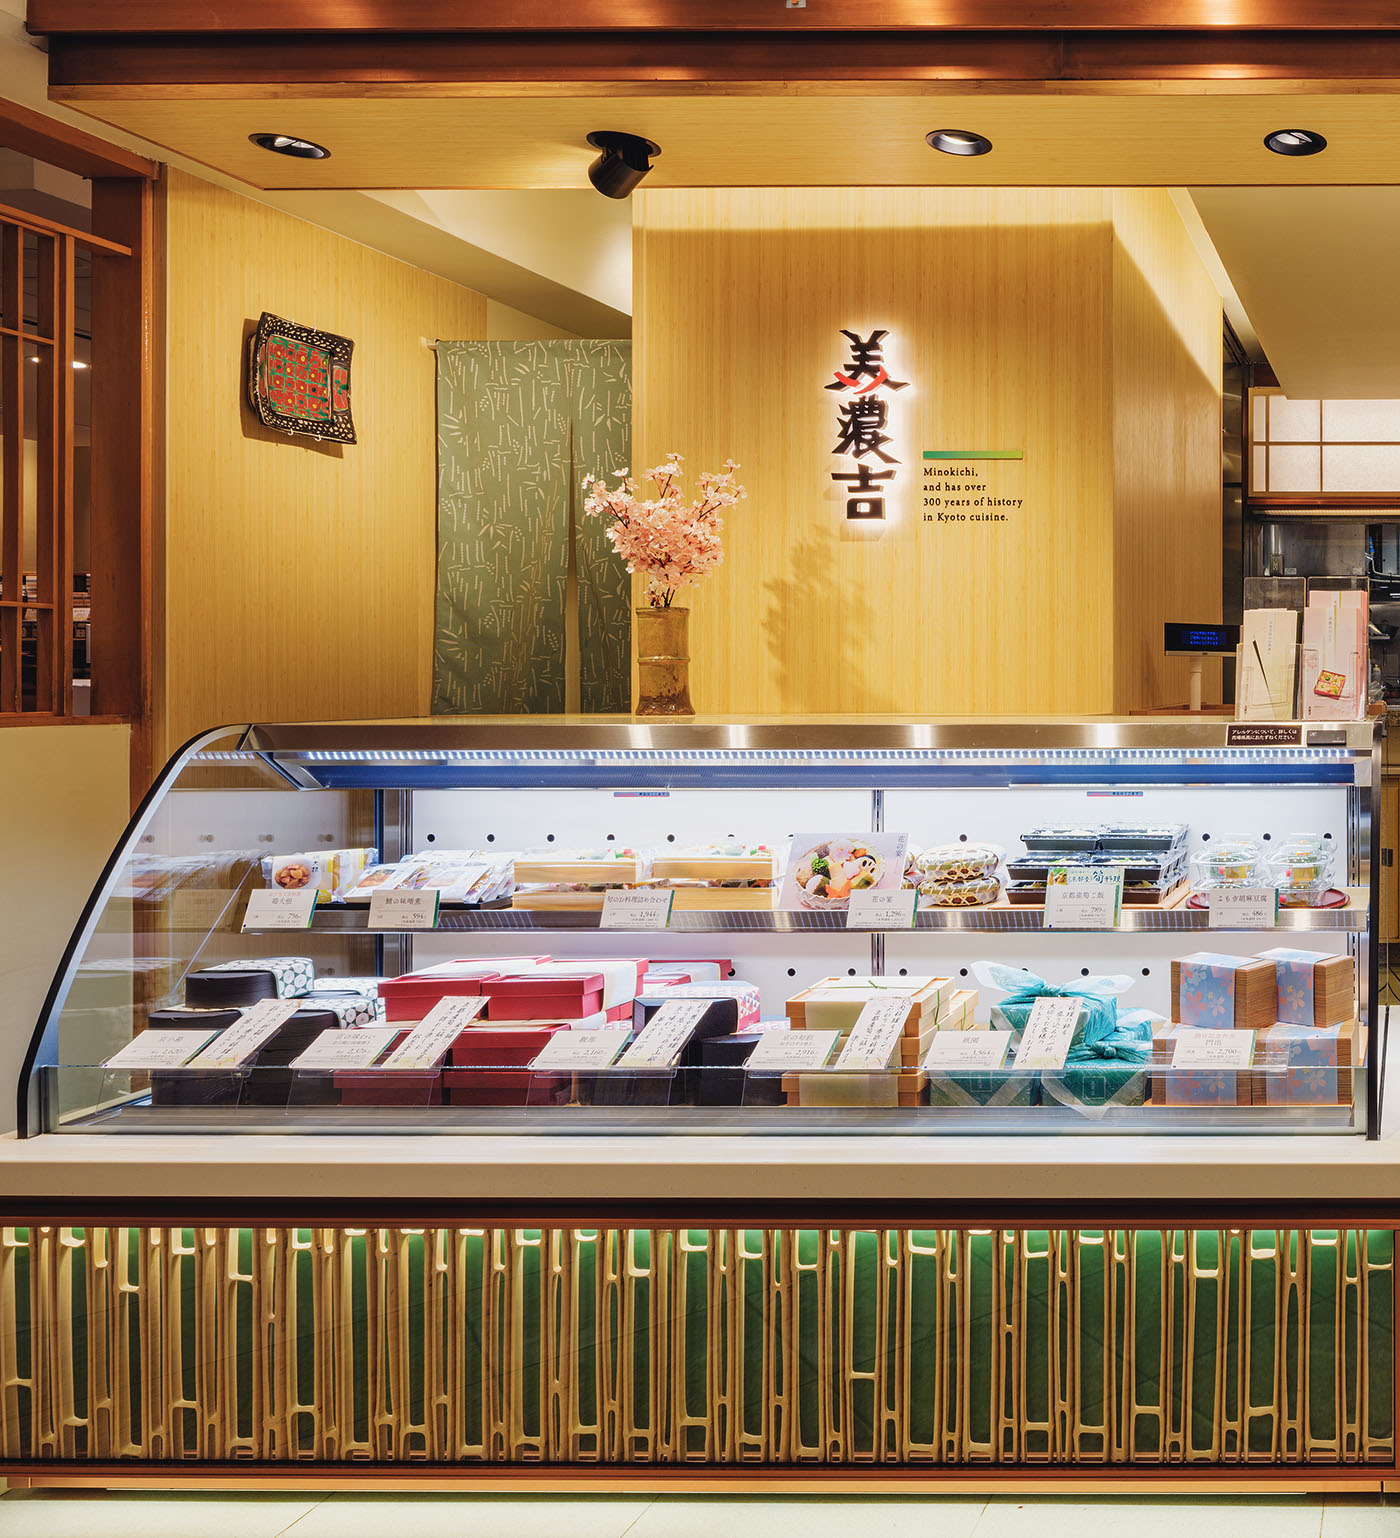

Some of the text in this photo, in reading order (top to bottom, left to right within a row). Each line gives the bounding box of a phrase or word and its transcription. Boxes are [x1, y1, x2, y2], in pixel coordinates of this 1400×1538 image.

[824, 330, 911, 520] 美濃吉
[923, 467, 979, 478] Minokichi,
[923, 482, 987, 492] and has over
[923, 497, 1024, 509] 300 years of history
[923, 512, 1009, 523] in Kyoto cuisine.
